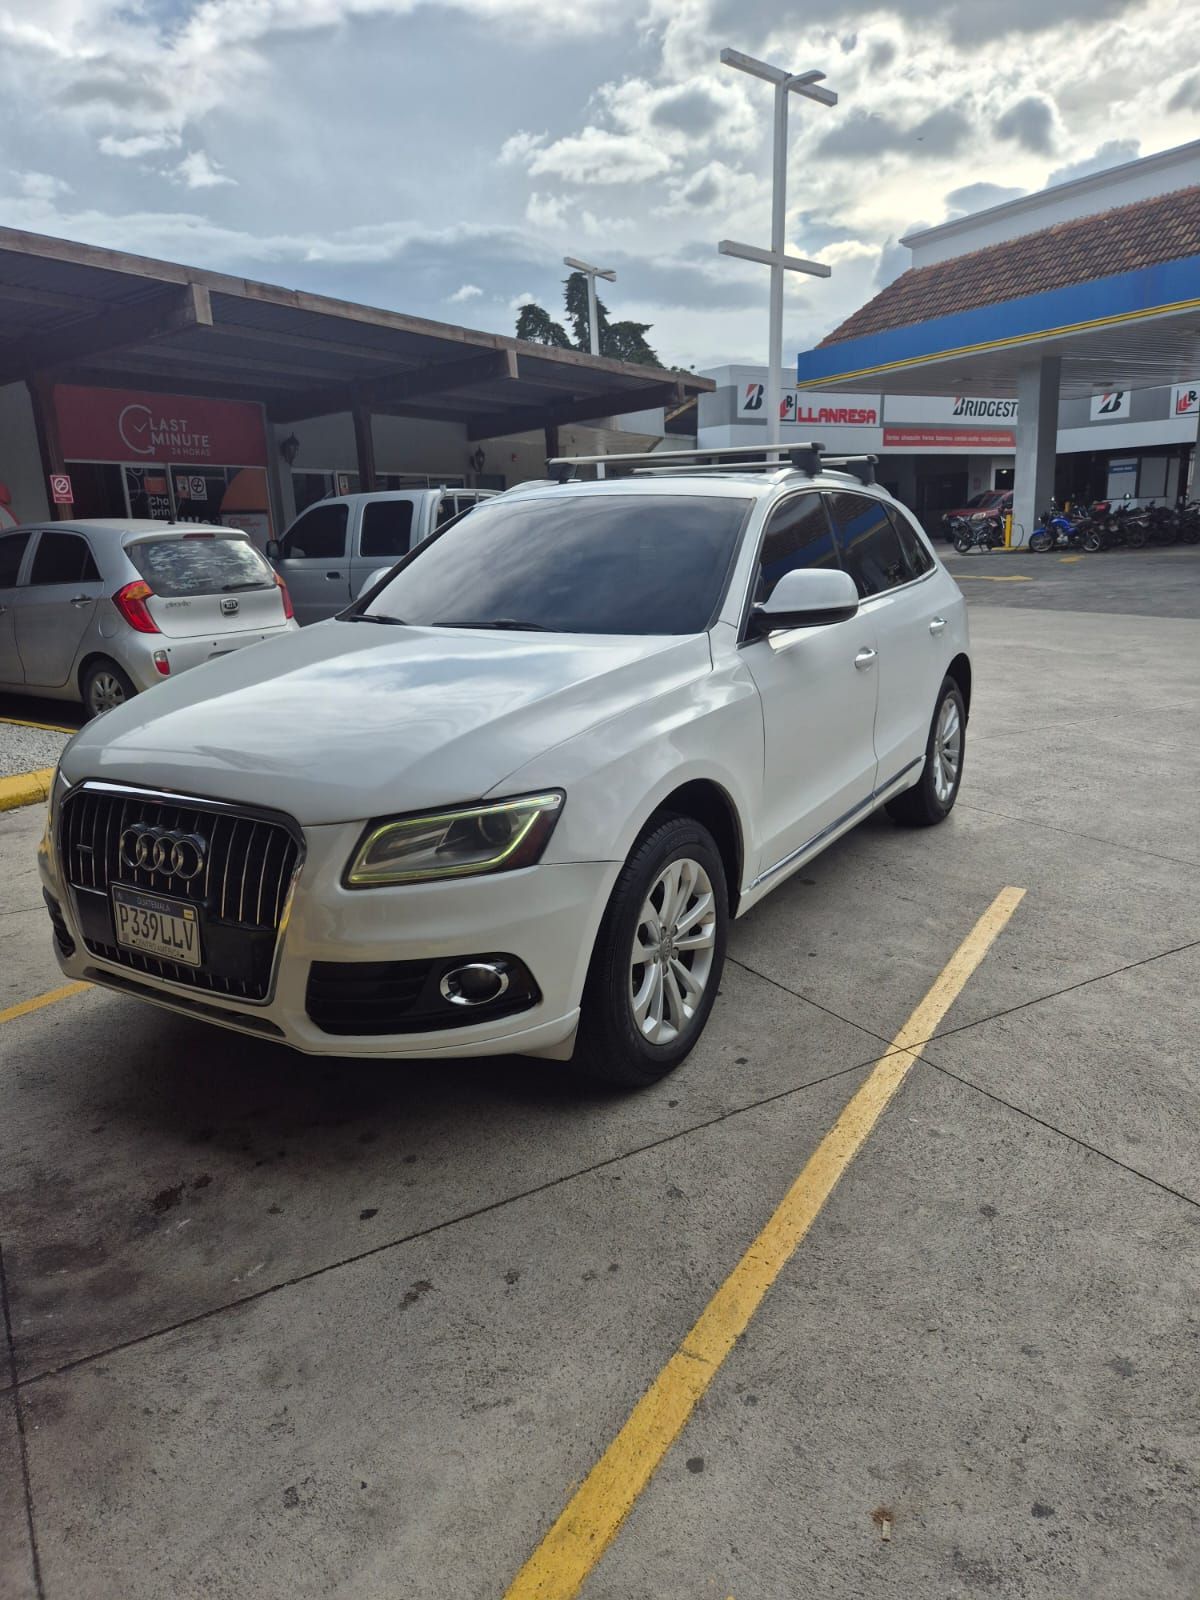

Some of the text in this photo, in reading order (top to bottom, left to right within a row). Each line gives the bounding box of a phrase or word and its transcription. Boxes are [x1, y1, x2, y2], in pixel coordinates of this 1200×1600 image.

[952, 394, 1019, 417] BRIDGEST
[798, 406, 877, 424] LLANRESA
[149, 417, 188, 432] LAST
[151, 431, 209, 447] MINUTE
[118, 903, 193, 951] P339LLV
